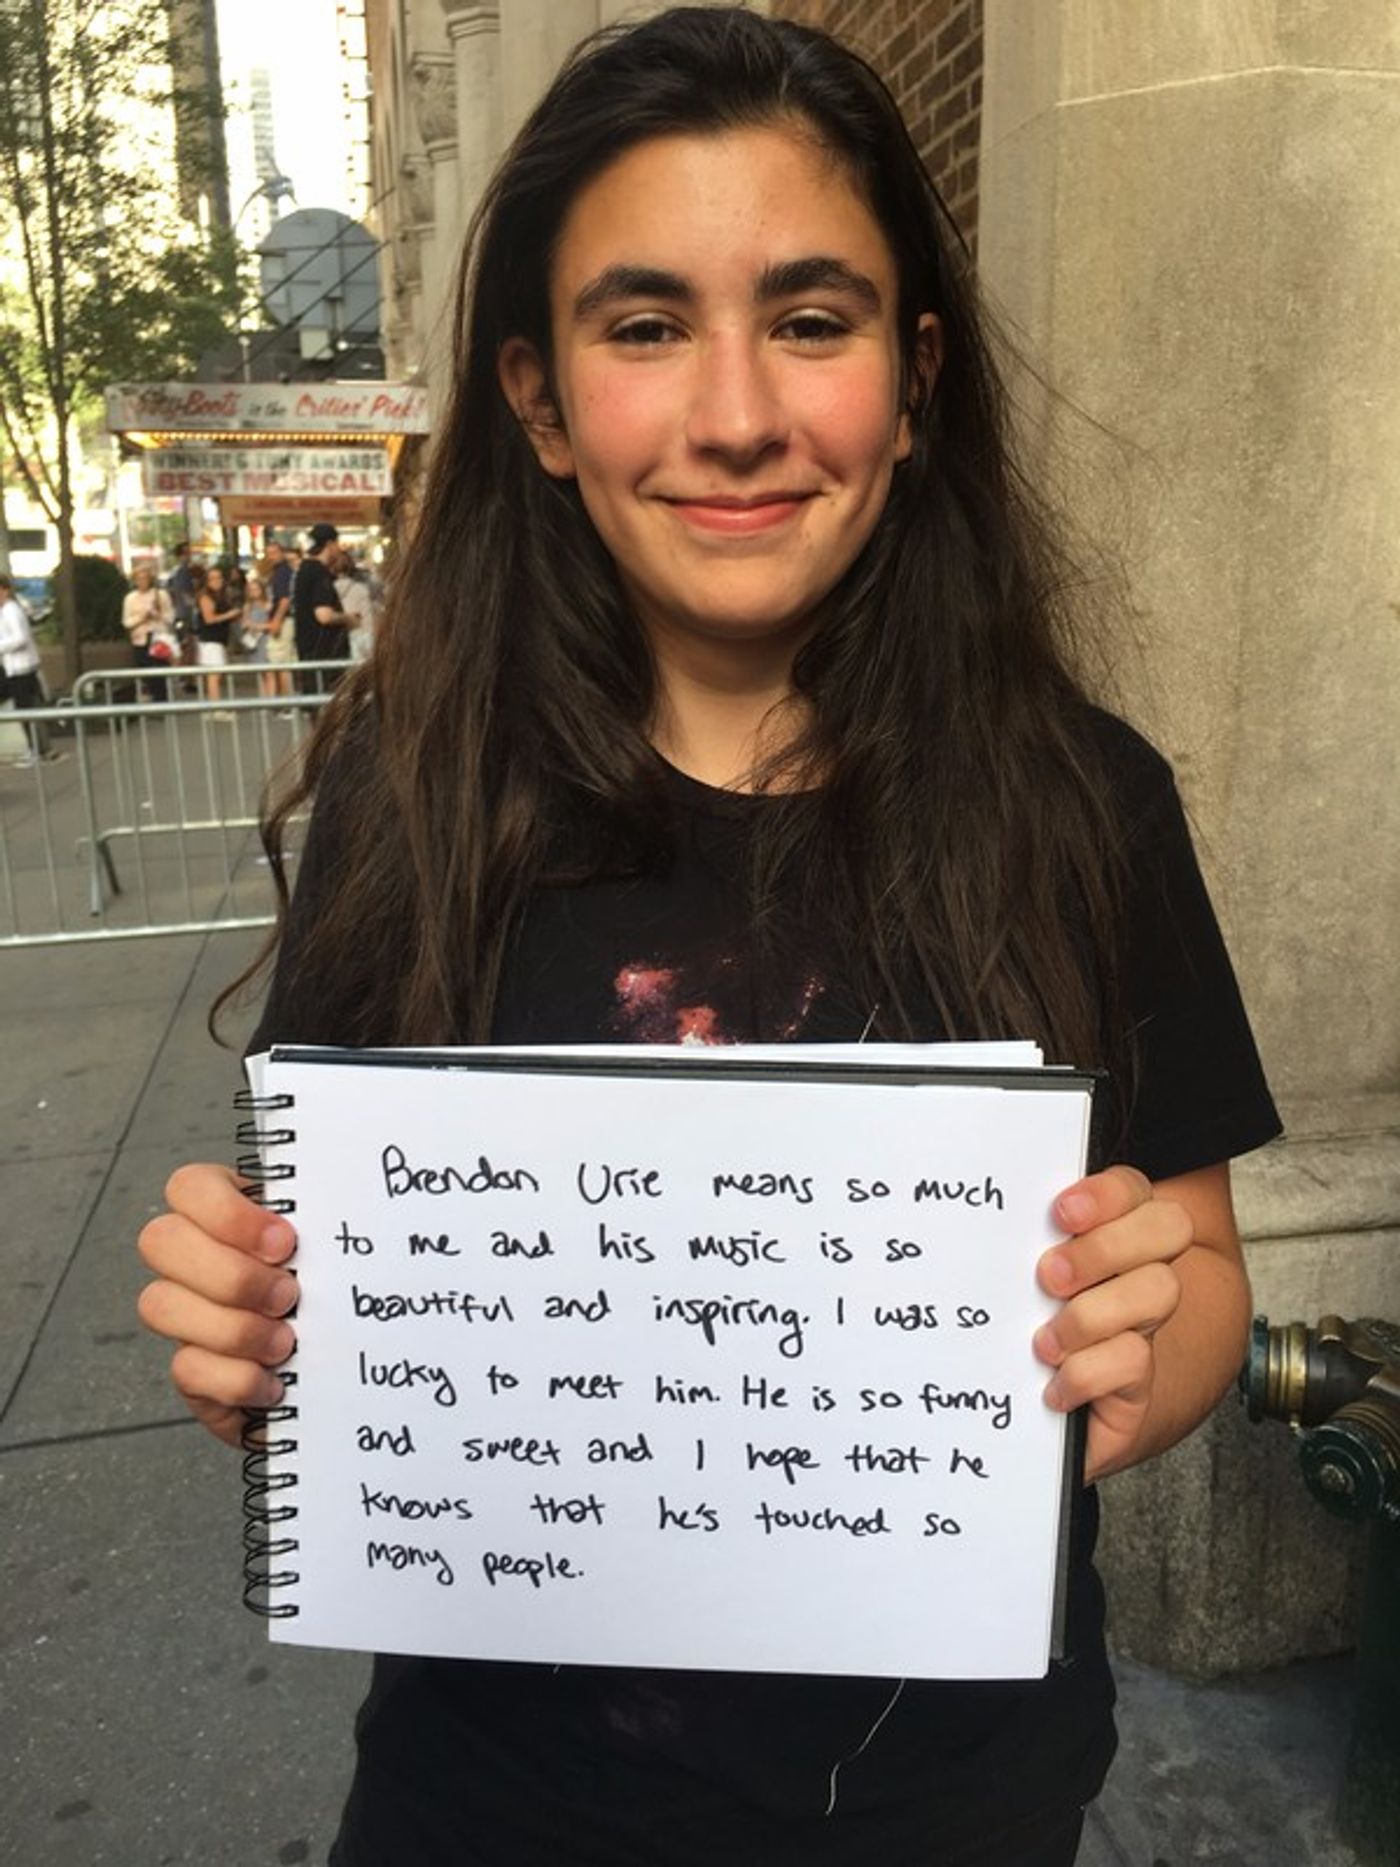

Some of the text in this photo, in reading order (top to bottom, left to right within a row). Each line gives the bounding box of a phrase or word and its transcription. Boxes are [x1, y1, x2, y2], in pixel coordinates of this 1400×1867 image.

[156, 472, 236, 491] BEST
[381, 1143, 1004, 1211] Brendon Urie means so much
[333, 1220, 923, 1268] to me and his music is so
[351, 1283, 991, 1360] beautiful and inspiring. I was so
[359, 1350, 1012, 1430] lucky to meet him. He is so funny
[355, 1424, 990, 1486] and sweet and I hope that he
[359, 1481, 962, 1538] knows that he's touched so
[366, 1540, 585, 1589] many people.
